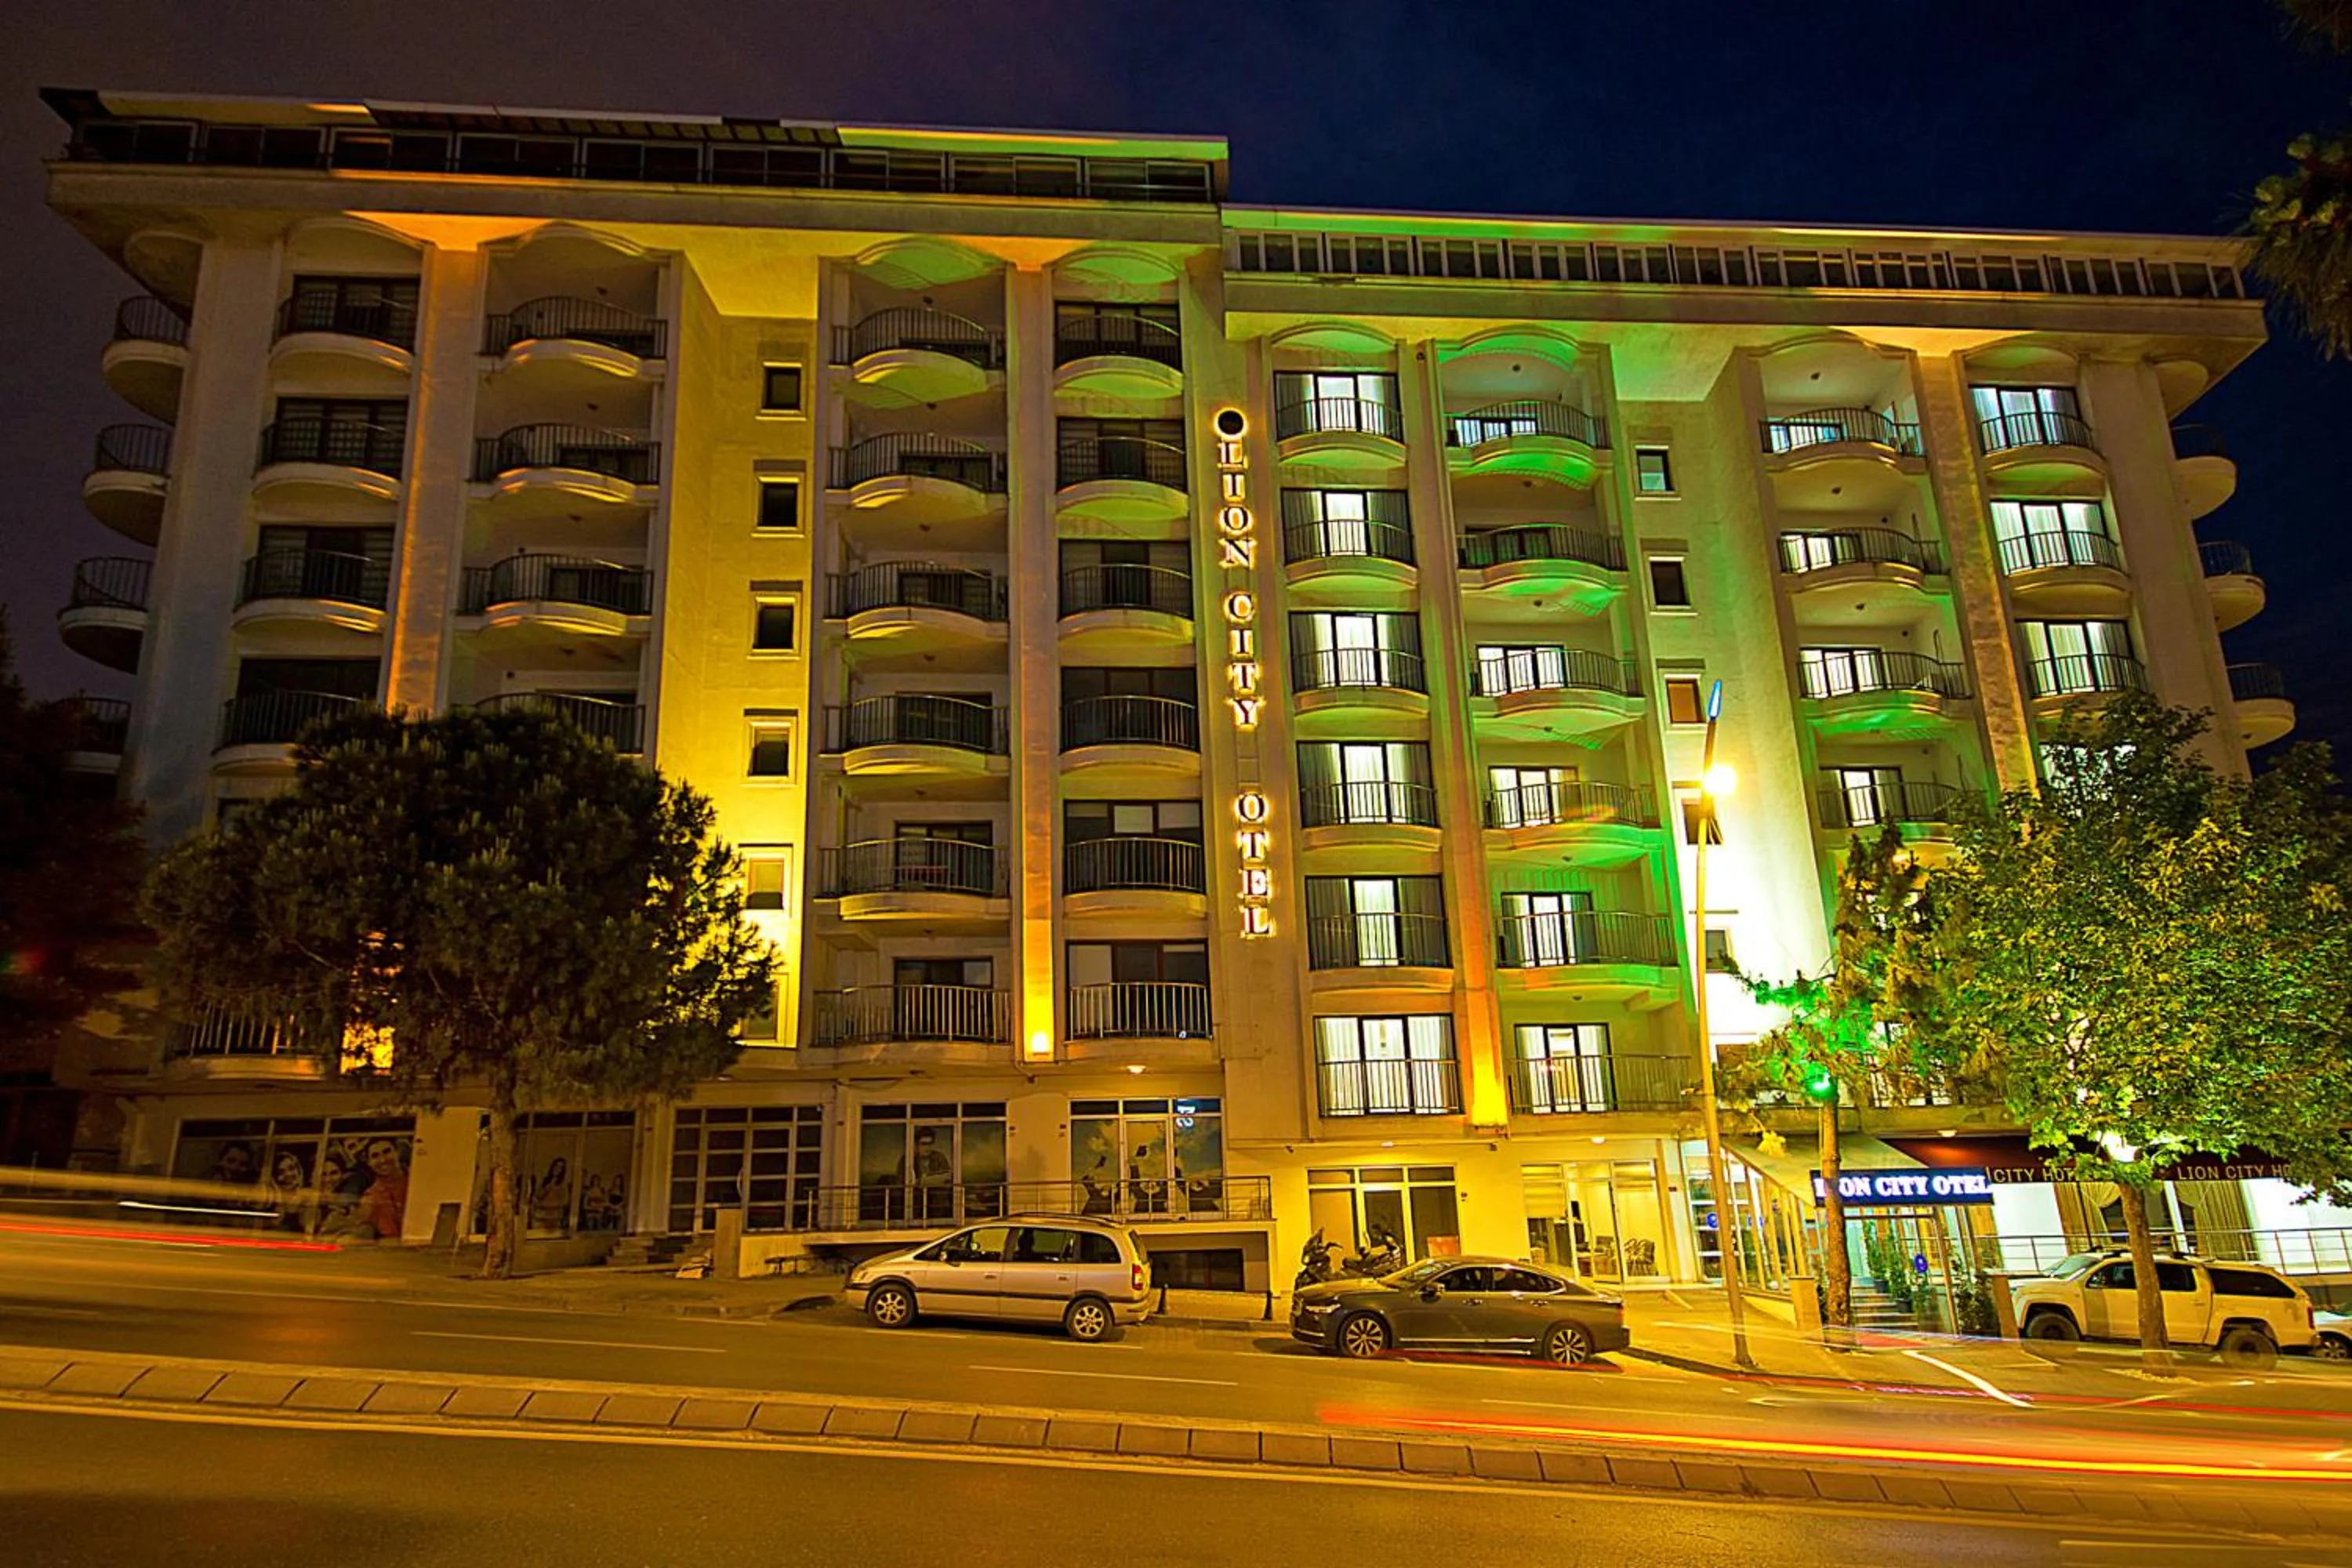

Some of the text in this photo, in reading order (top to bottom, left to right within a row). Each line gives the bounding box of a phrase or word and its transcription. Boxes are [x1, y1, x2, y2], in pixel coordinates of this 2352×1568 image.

[1217, 440, 1276, 938] LION CITY OTEL
[1994, 1167, 2034, 1182] CITY
[2177, 1166, 2220, 1180] LION
[2225, 1165, 2265, 1178] CITY
[1875, 1176, 1929, 1196] CITY
[1933, 1175, 1992, 1195] OTEL
